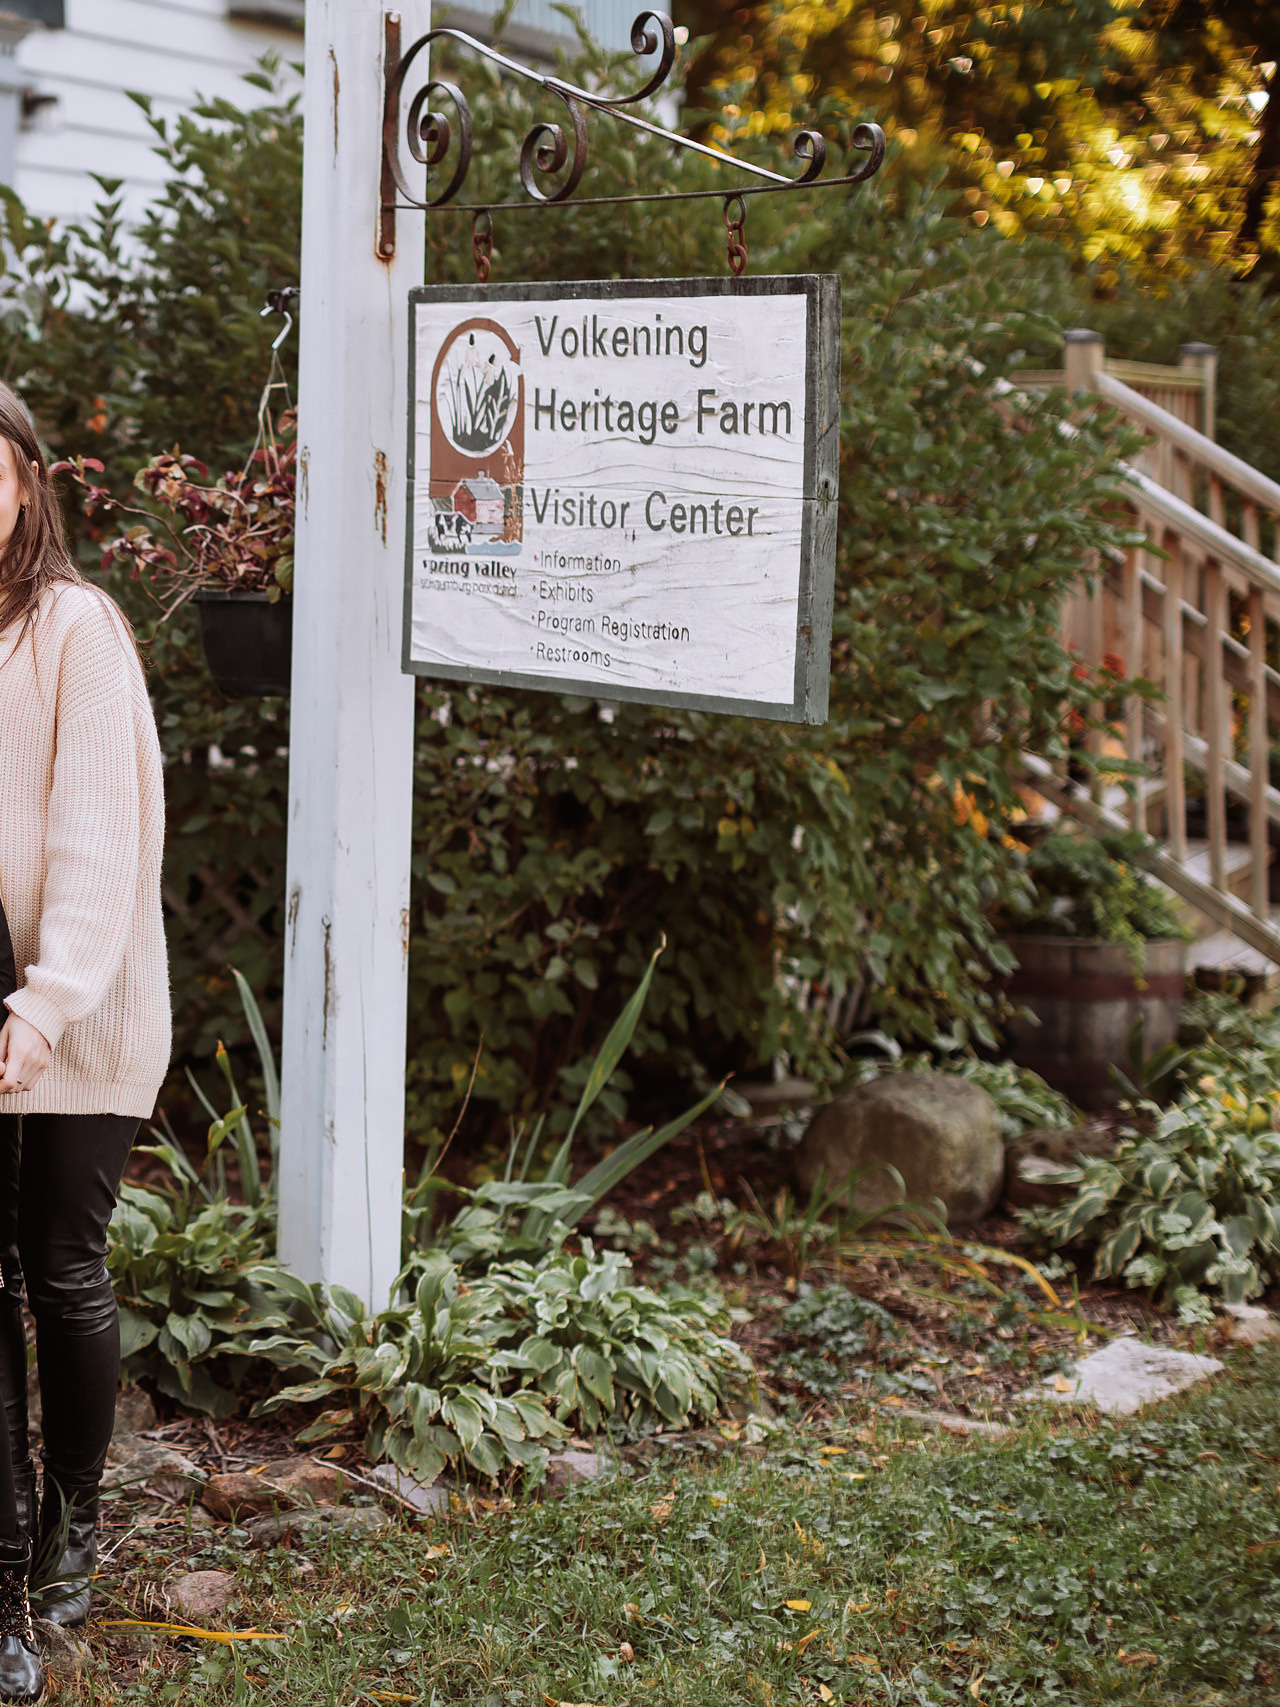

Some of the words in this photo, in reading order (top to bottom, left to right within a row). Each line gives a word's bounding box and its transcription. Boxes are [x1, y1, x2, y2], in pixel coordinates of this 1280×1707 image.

[534, 313, 708, 368] Volkening
[534, 388, 680, 445] Heritage
[697, 388, 792, 435] Farm
[530, 487, 630, 530] Visitor
[645, 490, 759, 536] Center
[540, 550, 621, 572] Information
[539, 580, 594, 603] Exhibits
[537, 610, 595, 636] Program
[601, 615, 690, 642] Registration
[536, 641, 611, 668] Restrooms
